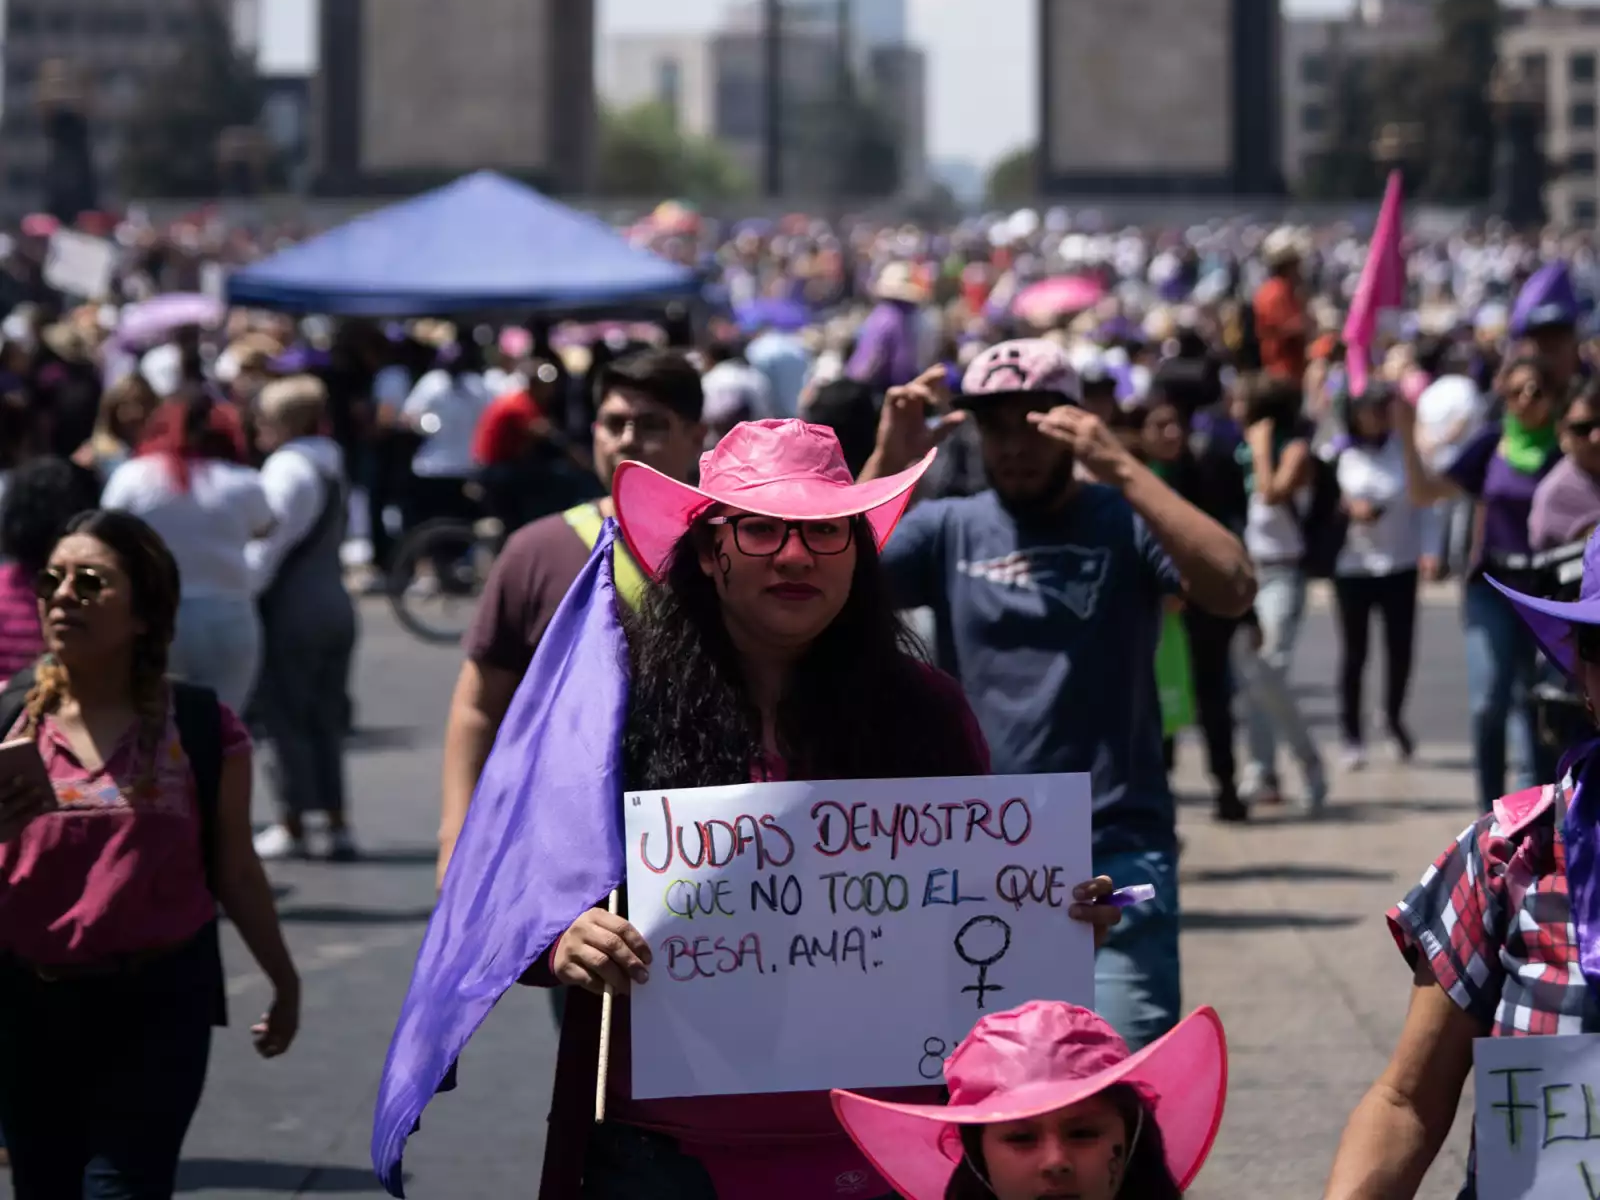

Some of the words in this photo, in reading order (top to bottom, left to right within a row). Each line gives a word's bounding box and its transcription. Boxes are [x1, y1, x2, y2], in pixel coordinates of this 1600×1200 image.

[811, 798, 1031, 860] DEMOSTRO
[664, 879, 735, 921] QUE
[751, 874, 802, 915] NO
[819, 871, 909, 916] TODO
[921, 867, 988, 907] EL
[996, 865, 1065, 911] QUE
